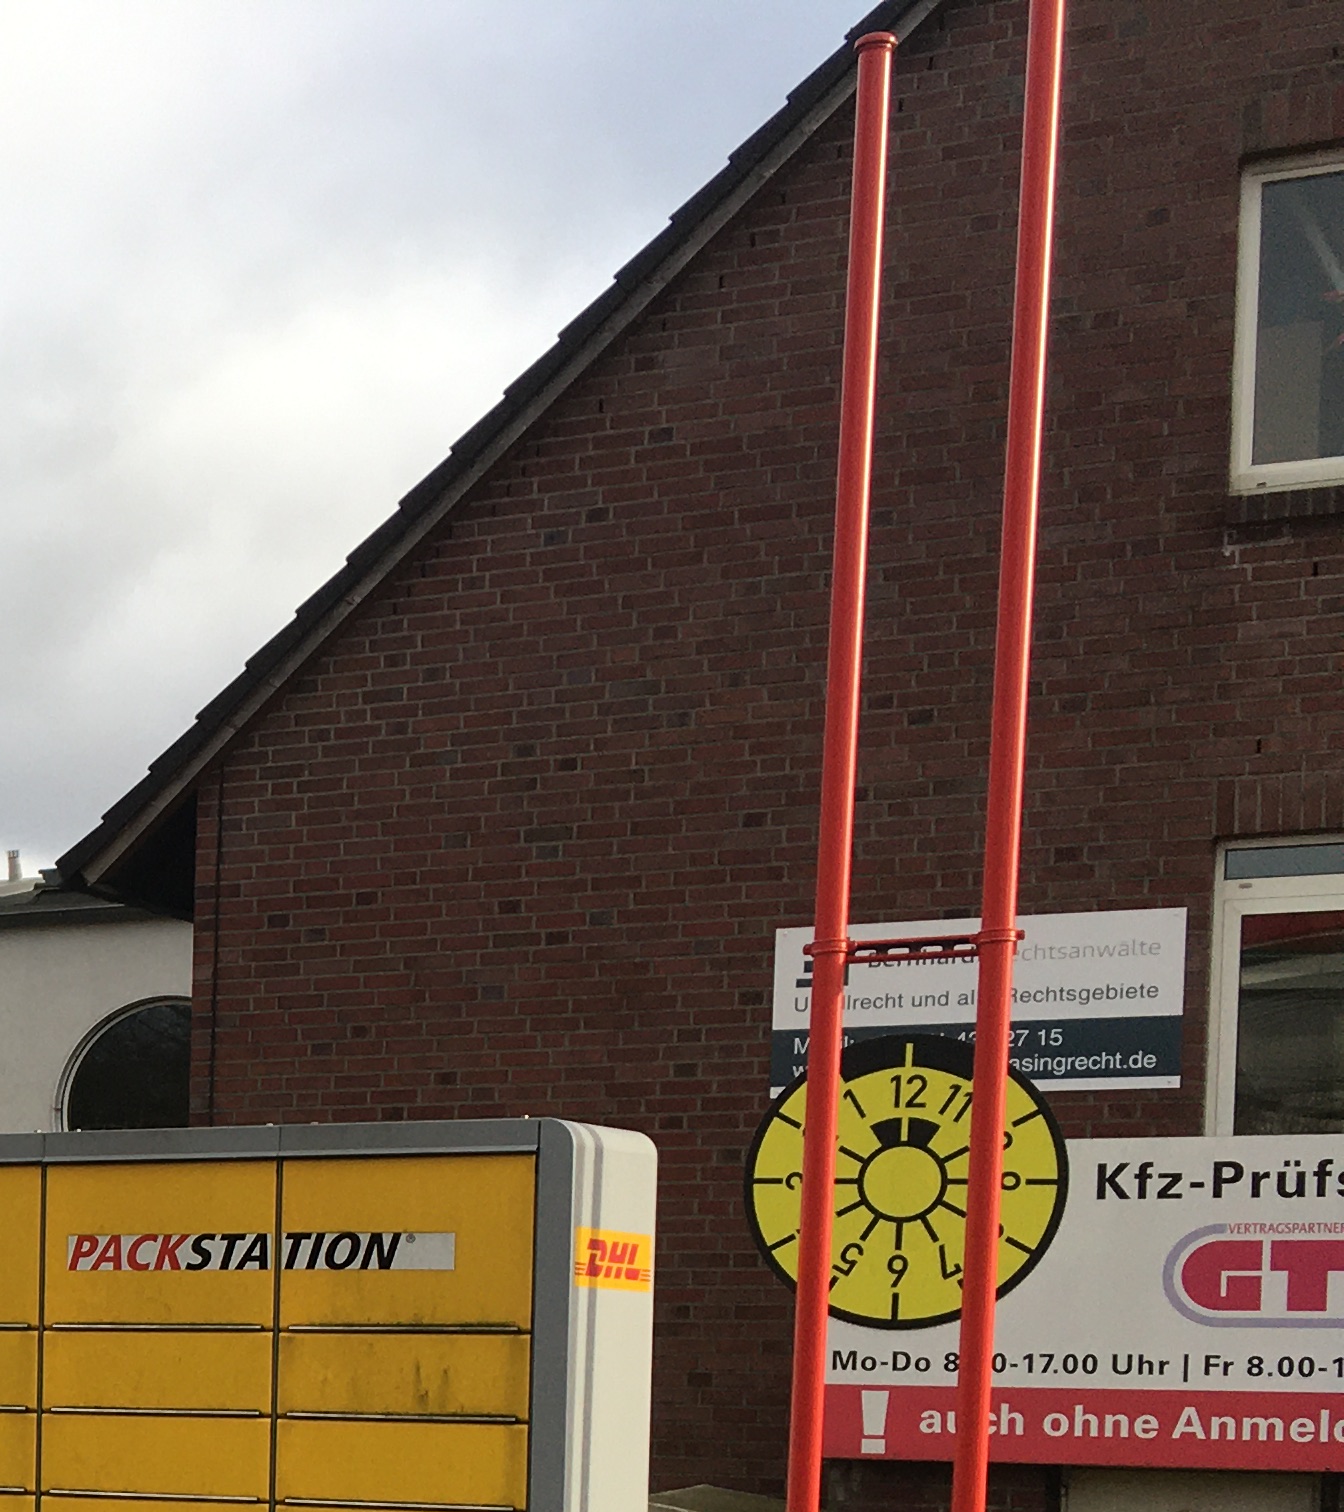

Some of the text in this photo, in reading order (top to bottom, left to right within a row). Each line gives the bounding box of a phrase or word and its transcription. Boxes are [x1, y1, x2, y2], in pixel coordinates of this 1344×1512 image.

[911, 990, 950, 1008] und
[1009, 982, 1160, 1006] Rechtsgebiete
[1037, 1028, 1064, 1047] 15
[842, 1087, 867, 1119] 1
[889, 1073, 928, 1109] 12
[938, 1083, 974, 1123] 11
[68, 1232, 402, 1271] PACKSTATION
[584, 1237, 642, 1281] DHL
[831, 1242, 865, 1277] 5
[831, 1349, 932, 1373] Mo-Do
[943, 1352, 1099, 1375] 80-17.00
[1111, 1353, 1171, 1376] Uhr
[1203, 1354, 1235, 1377] Fr
[1042, 1403, 1160, 1440] ohne
